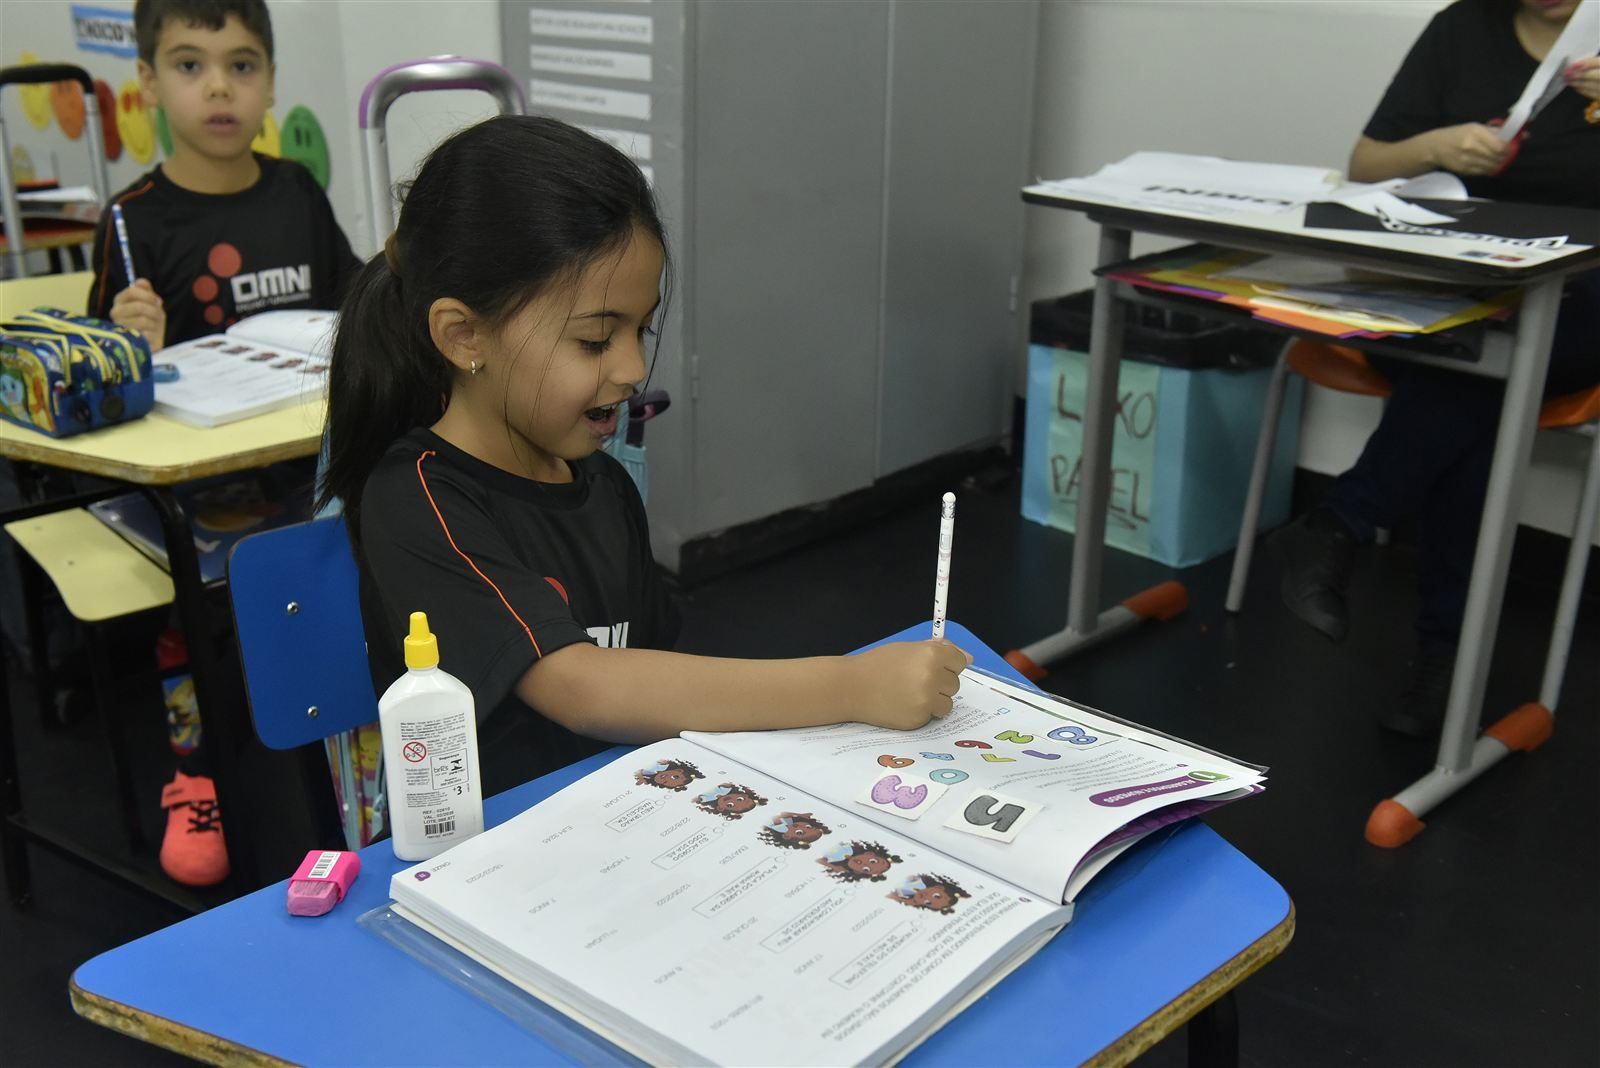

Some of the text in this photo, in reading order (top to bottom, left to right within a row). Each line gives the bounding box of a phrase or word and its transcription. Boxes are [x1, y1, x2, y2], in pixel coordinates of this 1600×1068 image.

[230, 264, 312, 304] OMNI
[1057, 373, 1157, 440] LXO
[1051, 454, 1149, 523] PAEL
[995, 730, 1035, 744] 2
[1047, 726, 1098, 746] 8
[877, 754, 915, 769] 9
[980, 753, 1016, 763] 7
[1021, 749, 1061, 761] 1
[871, 774, 928, 810] 3
[964, 794, 1025, 832] 5
